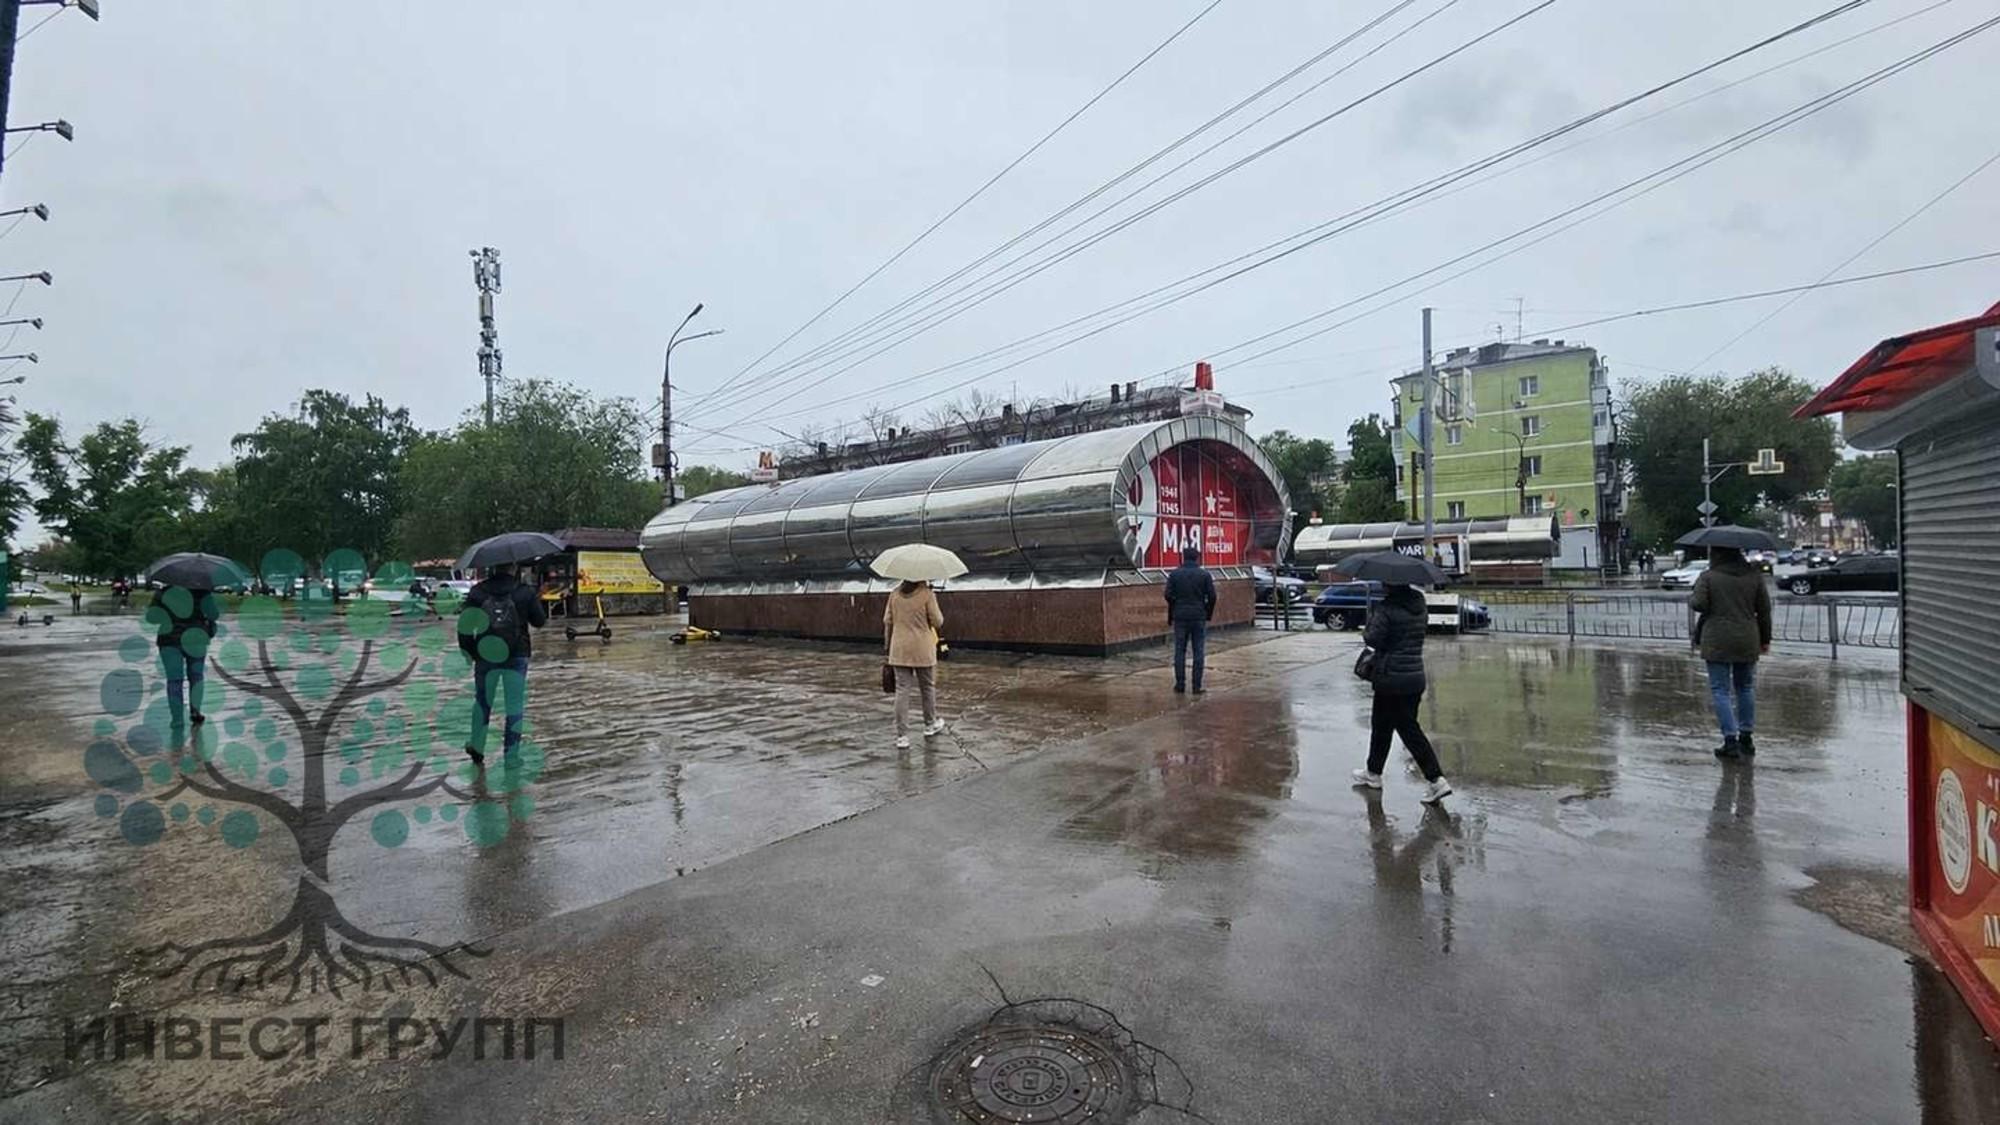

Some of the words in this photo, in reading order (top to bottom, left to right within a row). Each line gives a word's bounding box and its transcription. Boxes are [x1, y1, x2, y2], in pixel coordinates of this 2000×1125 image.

[1160, 486, 1178, 499] 1941
[1161, 503, 1180, 515] 1945
[1163, 522, 1201, 554] МАЯ
